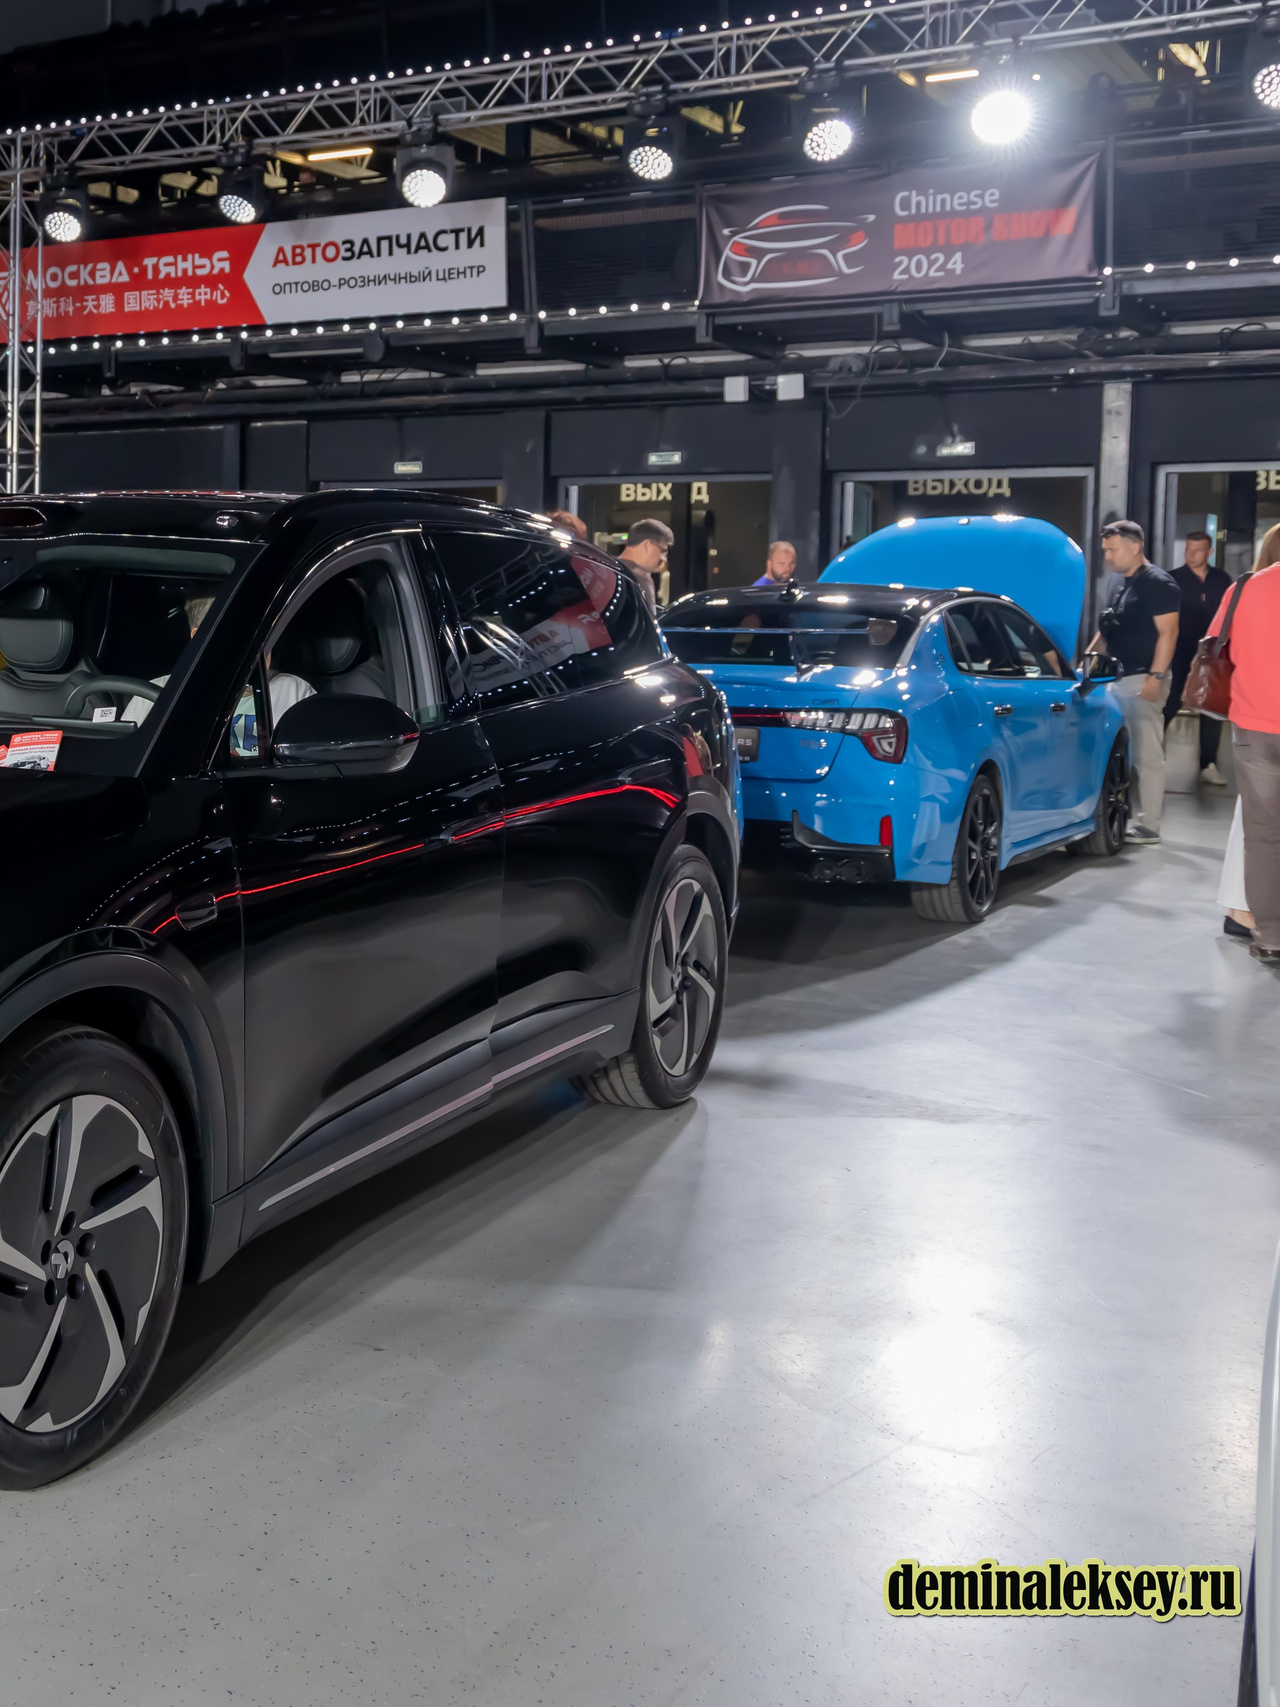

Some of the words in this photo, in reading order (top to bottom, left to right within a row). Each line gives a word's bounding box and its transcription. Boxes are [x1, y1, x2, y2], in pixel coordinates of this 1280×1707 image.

[893, 188, 1000, 216] Chinese
[272, 225, 486, 268] АВТОЗАПЧАСТИ
[893, 216, 985, 250] MOTOR
[143, 251, 230, 279] ТЯНЬЯ
[892, 252, 965, 280] 2024
[272, 267, 432, 295] ОПТОВО-РОЗНИЧНЫЙ
[436, 265, 486, 283] ЦЕНТР
[124, 283, 230, 313] 国际汽车中心
[620, 481, 709, 504] ВЫХД
[907, 477, 1011, 497] ВЫХОД
